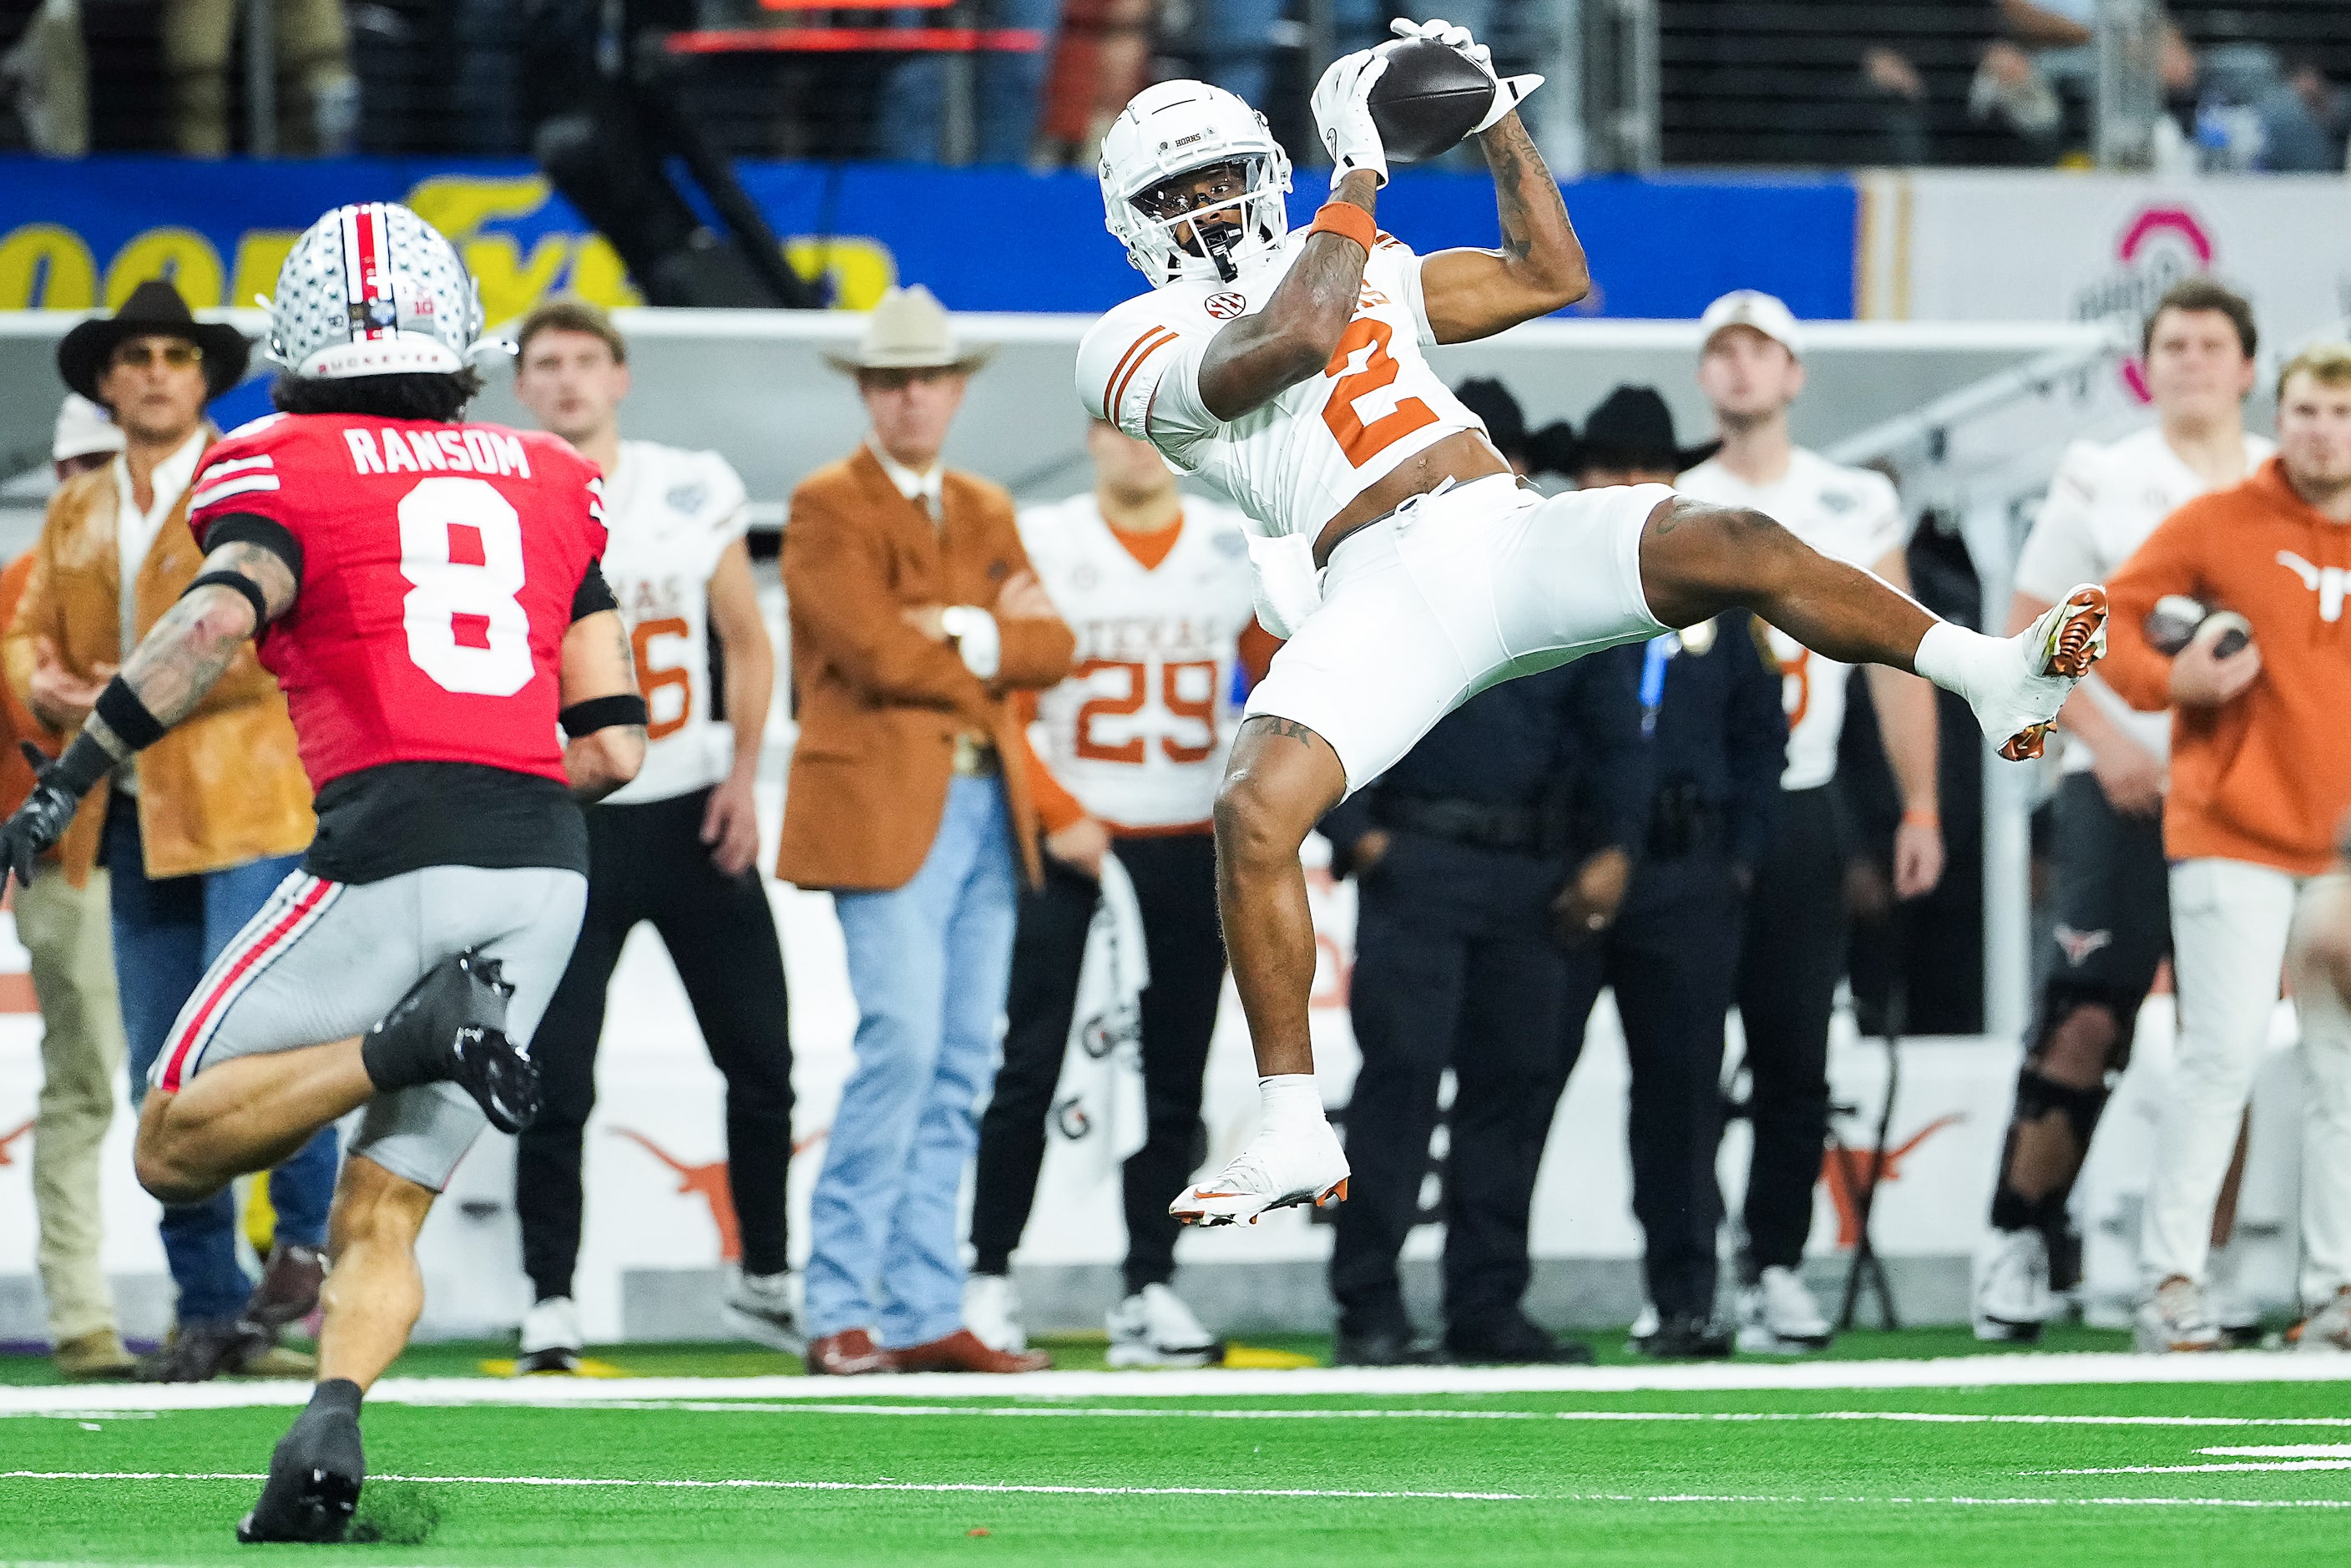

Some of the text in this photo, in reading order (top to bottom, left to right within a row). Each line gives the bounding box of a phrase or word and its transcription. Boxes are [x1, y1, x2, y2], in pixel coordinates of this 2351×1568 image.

[1175, 133, 1201, 148] HORNS
[1205, 292, 1246, 319] SEC
[1321, 316, 1440, 469] 2
[342, 427, 531, 479] RANSOM
[397, 476, 536, 697] 8
[1073, 658, 1219, 764] 29
